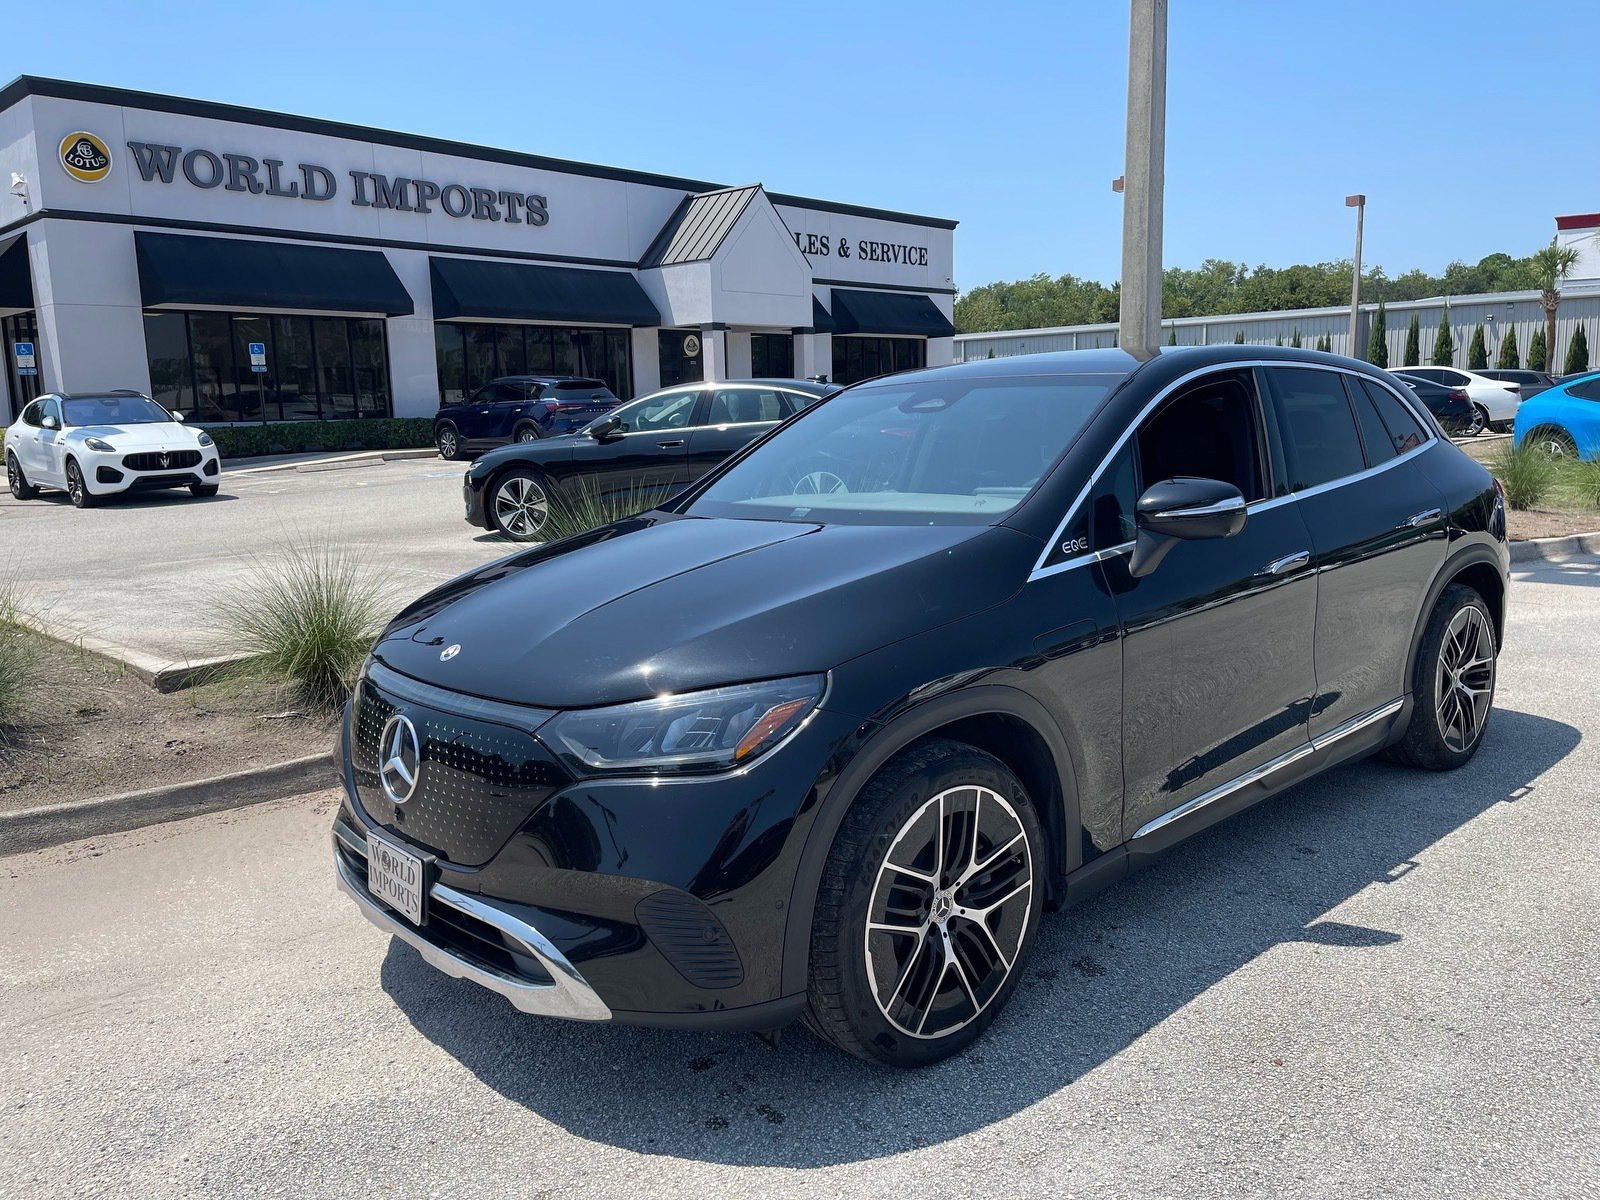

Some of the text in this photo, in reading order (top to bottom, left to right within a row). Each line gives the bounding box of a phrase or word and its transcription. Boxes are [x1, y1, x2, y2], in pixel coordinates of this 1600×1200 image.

[67, 154, 107, 168] LOTUS
[127, 141, 550, 226] WORLD IMPORTS
[794, 232, 928, 266] LES & SERVICE
[1062, 536, 1089, 554] EQE
[371, 844, 416, 886] WORLD
[369, 864, 418, 913] IMPORTS
